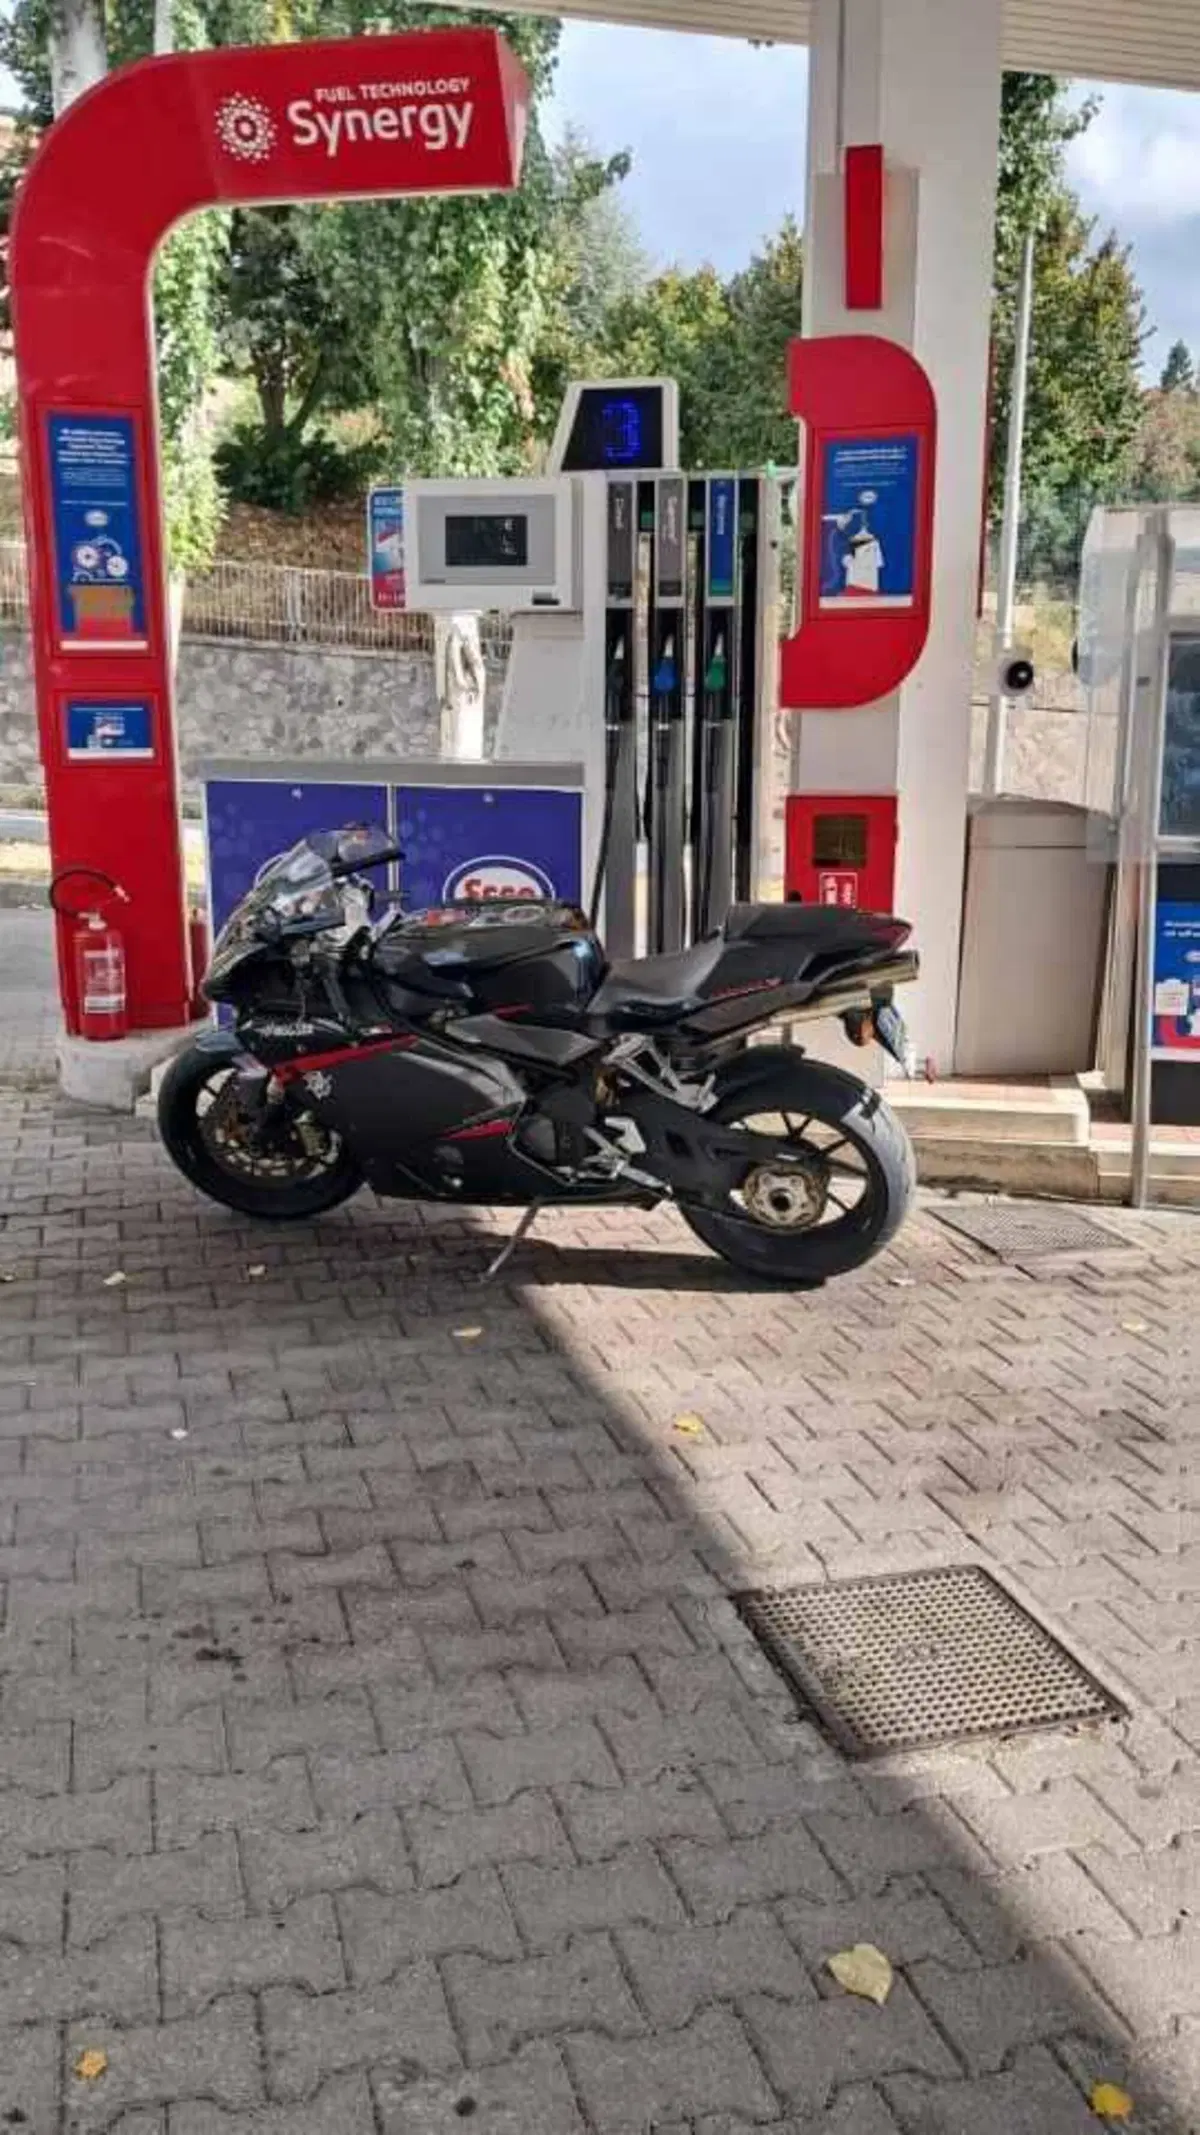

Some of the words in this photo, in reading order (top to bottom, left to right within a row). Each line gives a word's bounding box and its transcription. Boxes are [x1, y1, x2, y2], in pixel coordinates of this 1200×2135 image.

[314, 86, 356, 102] FUEL
[359, 77, 470, 99] TECHNOLOGY
[287, 100, 474, 158] Synergy
